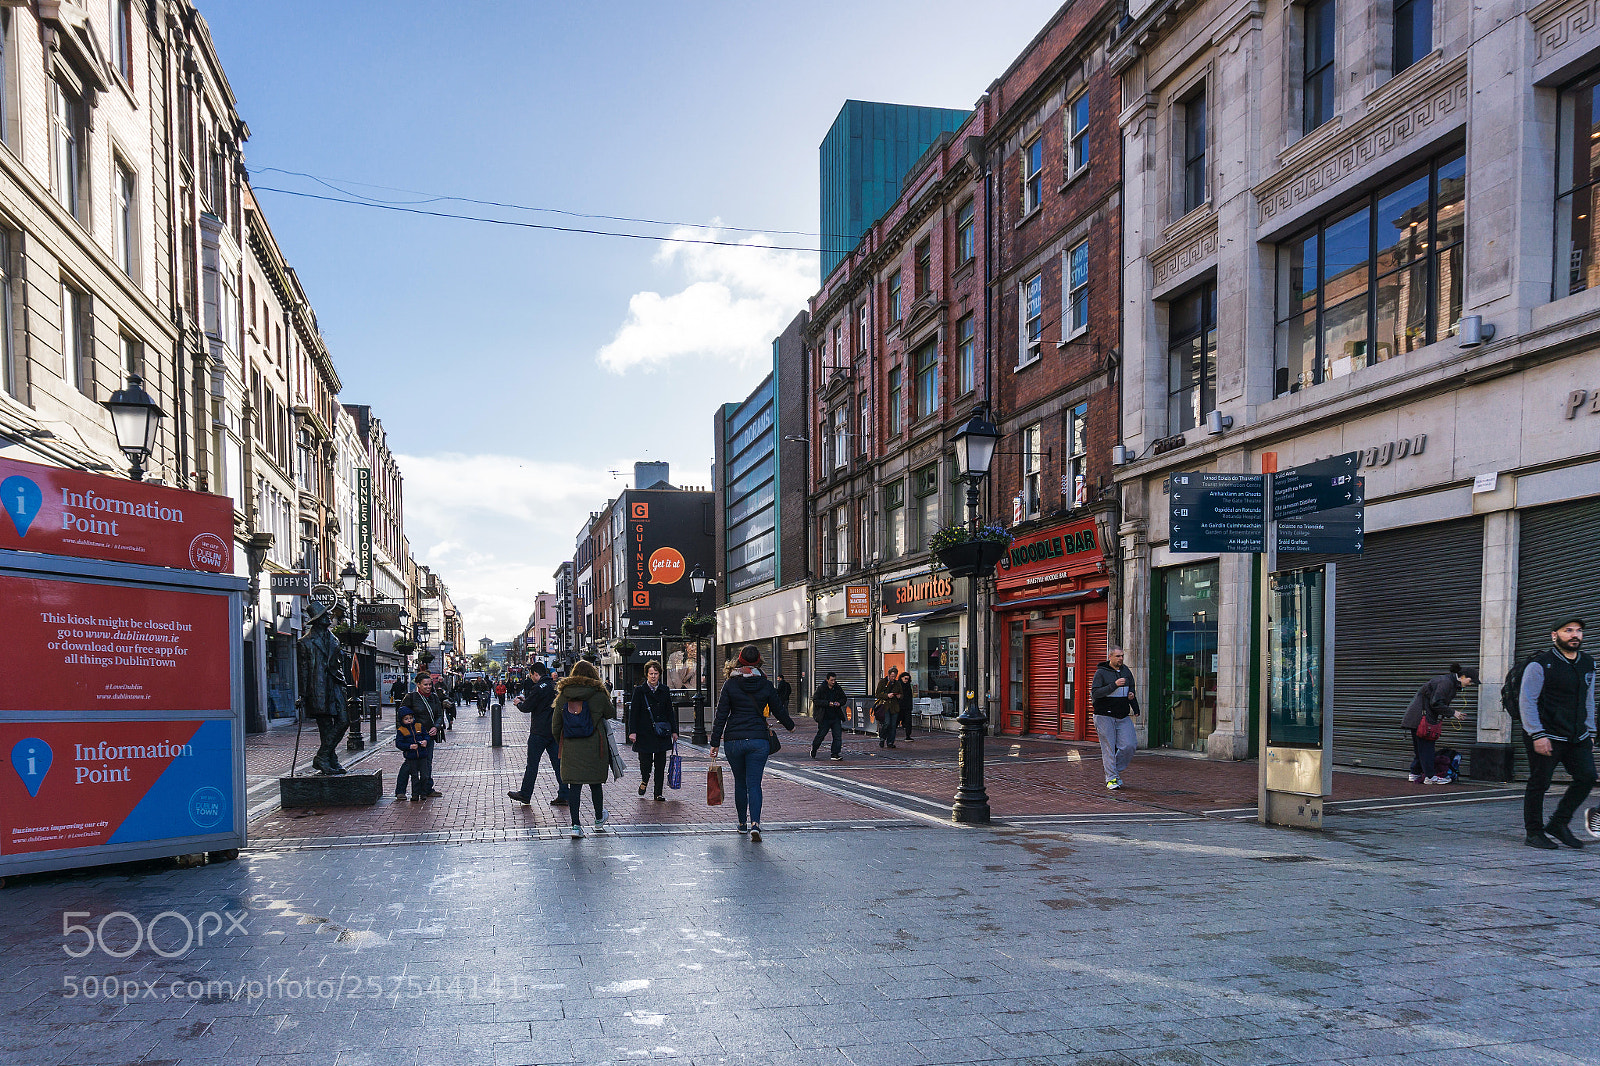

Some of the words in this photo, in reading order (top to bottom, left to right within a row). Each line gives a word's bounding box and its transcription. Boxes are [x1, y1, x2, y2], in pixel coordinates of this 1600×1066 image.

[60, 486, 184, 523] Information
[360, 470, 368, 522] DUNNES
[634, 504, 646, 516] G
[61, 511, 119, 537] Point
[197, 548, 222, 560] DUBLIN
[362, 525, 370, 578] STORES
[1010, 537, 1064, 567] NOODLE
[1064, 529, 1096, 554] BAR
[197, 555, 221, 567] TOWN
[652, 559, 665, 572] Get
[666, 559, 672, 568] it
[672, 559, 680, 568] at
[272, 576, 308, 587] DUFFY'S
[896, 574, 952, 604] saburritos
[636, 593, 646, 604] G
[40, 612, 66, 624] This
[67, 614, 96, 626] kiosk
[98, 616, 130, 630] might
[130, 618, 143, 629] be
[144, 620, 176, 630] closed
[176, 621, 192, 632] but
[57, 629, 71, 640] go
[72, 628, 84, 638] to
[84, 630, 180, 643] www.dublintown.ie
[48, 642, 60, 650] or
[62, 640, 114, 653] download
[115, 644, 133, 654] our
[134, 644, 154, 654] free
[154, 646, 173, 658] app
[174, 646, 188, 656] for
[64, 654, 78, 664] all
[80, 654, 113, 668] things
[115, 656, 176, 668] DublinTown
[74, 740, 193, 762] Information
[75, 764, 132, 785] Point
[12, 826, 50, 834] Businesses
[50, 822, 84, 832] improving
